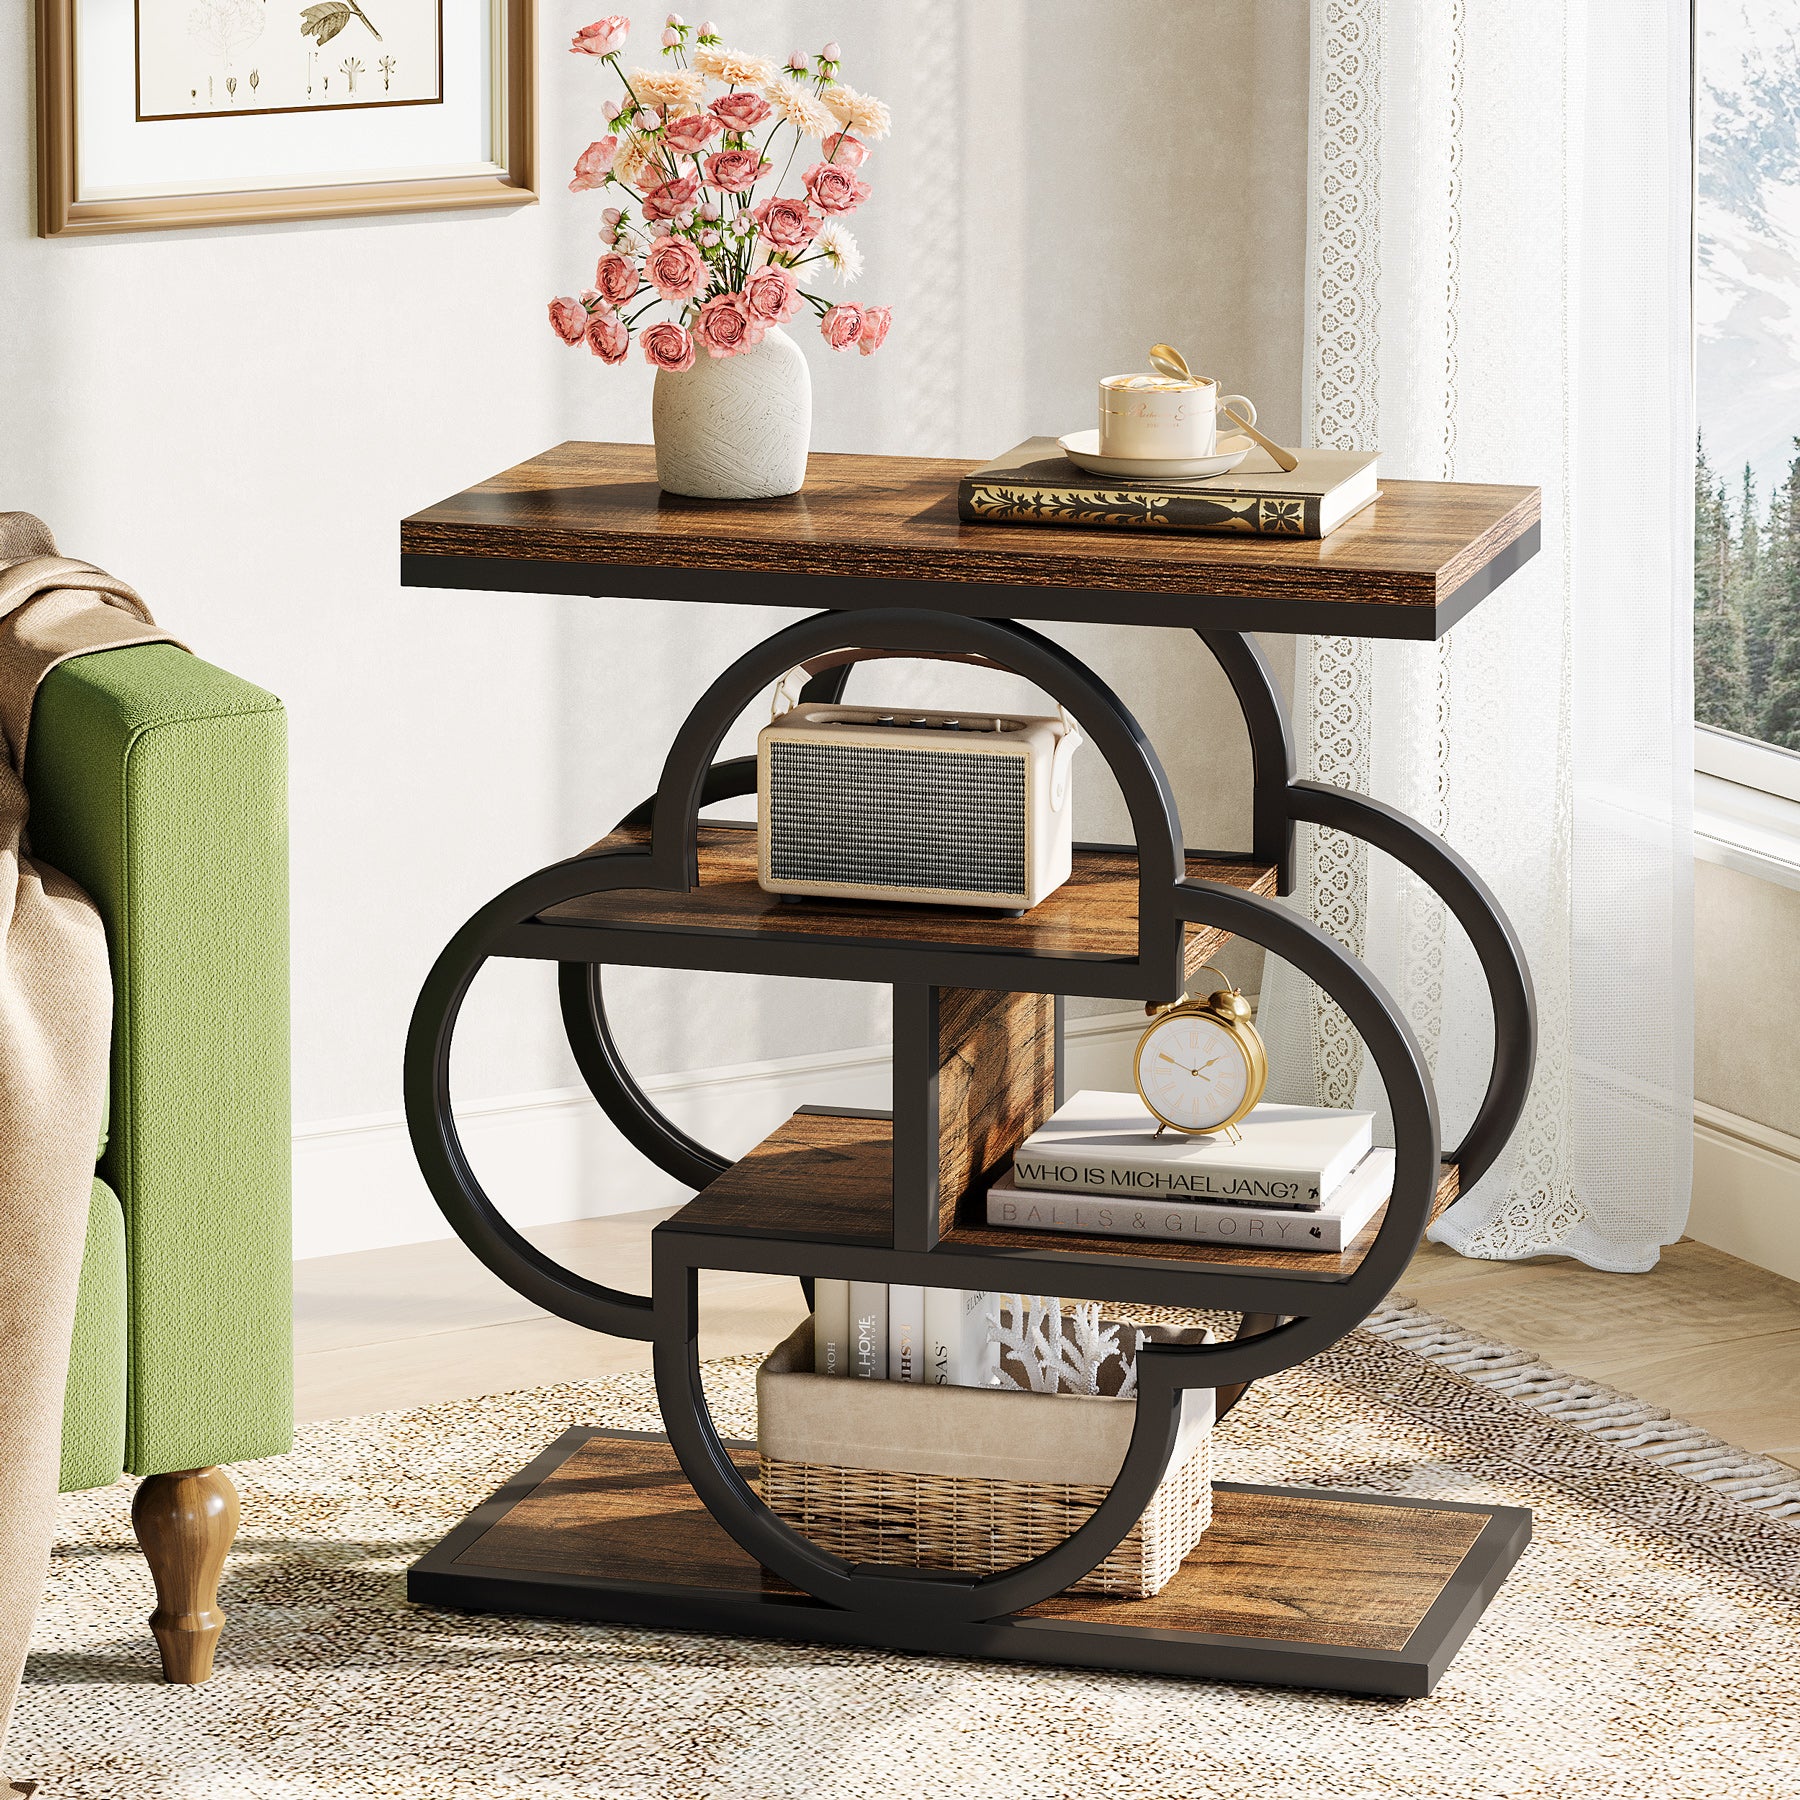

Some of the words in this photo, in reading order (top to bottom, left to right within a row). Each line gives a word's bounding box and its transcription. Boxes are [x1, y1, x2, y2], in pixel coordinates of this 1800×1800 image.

[1016, 1162, 1078, 1183] WHO
[1084, 1167, 1105, 1185] IS
[1111, 1169, 1219, 1194] MICHAEL
[1222, 1178, 1299, 1199] JANG?
[1003, 1203, 1113, 1228] BALLS
[1132, 1211, 1147, 1230] &
[1164, 1213, 1291, 1239] GLORY
[858, 1315, 871, 1366] HOME
[901, 1324, 912, 1383] FASHI
